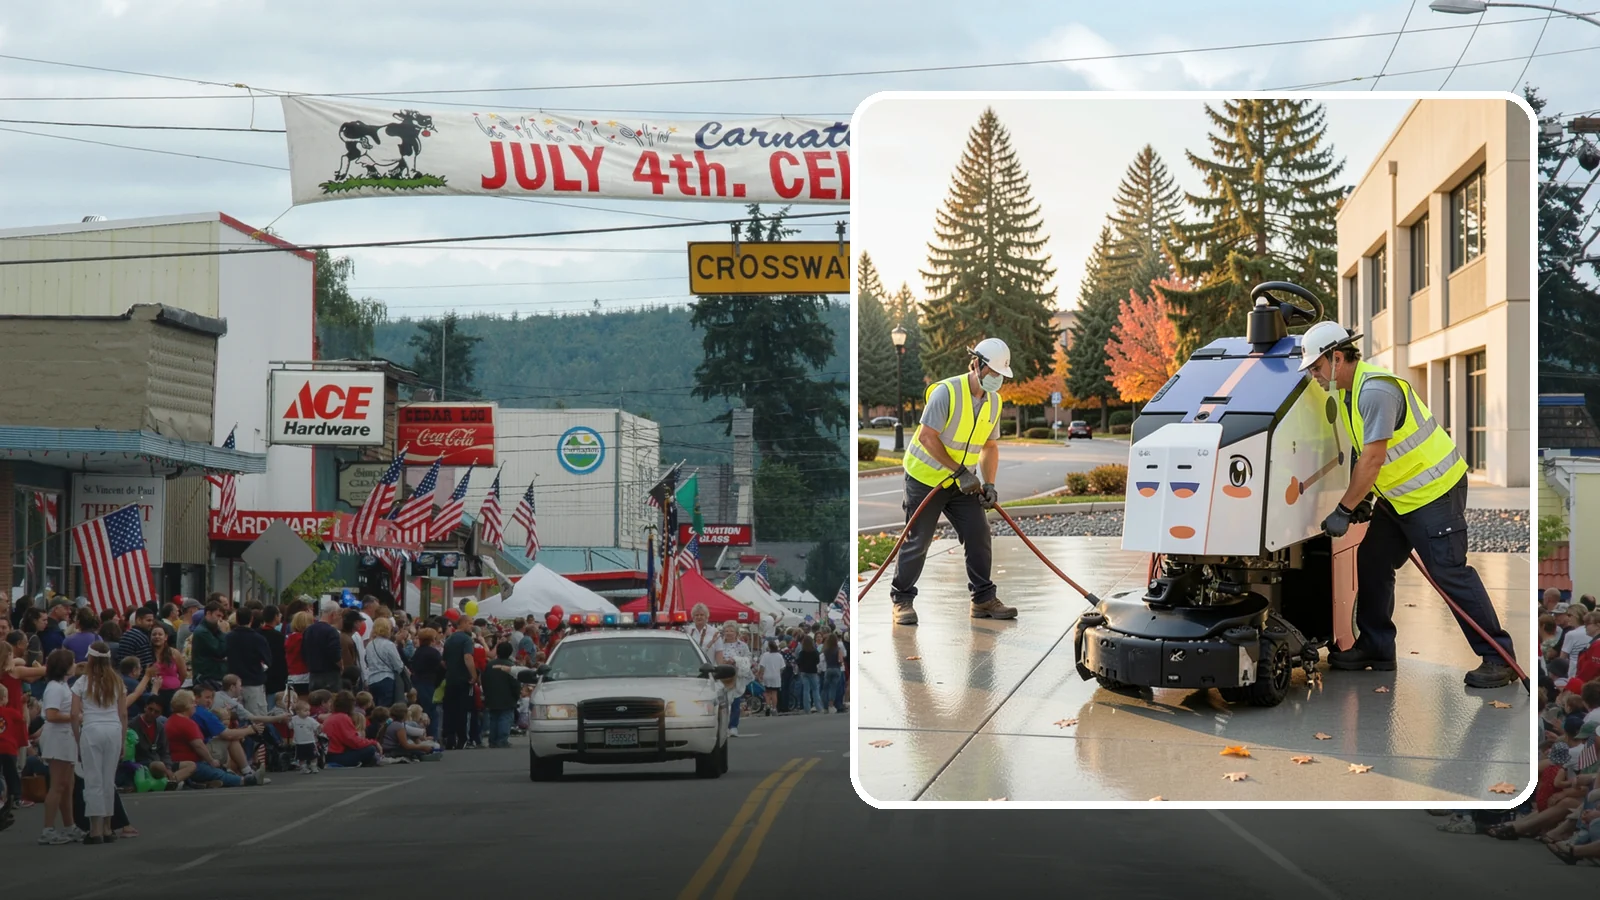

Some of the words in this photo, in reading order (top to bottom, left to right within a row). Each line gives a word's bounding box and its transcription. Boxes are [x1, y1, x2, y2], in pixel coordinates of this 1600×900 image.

[481, 141, 605, 192] JULY
[632, 150, 746, 197] 4th.
[697, 254, 850, 280] CROSSWA
[282, 380, 373, 420] ACE
[405, 409, 453, 422] CEDAR
[283, 421, 370, 436] Hardware
[416, 428, 477, 447] Coca-Cola
[353, 467, 387, 480] Simpl
[96, 485, 124, 495] Vincent
[126, 486, 136, 495] de
[138, 486, 155, 495] Paul
[81, 503, 154, 522] THT
[688, 526, 741, 535] CRNATION
[699, 535, 730, 543] GLASS
